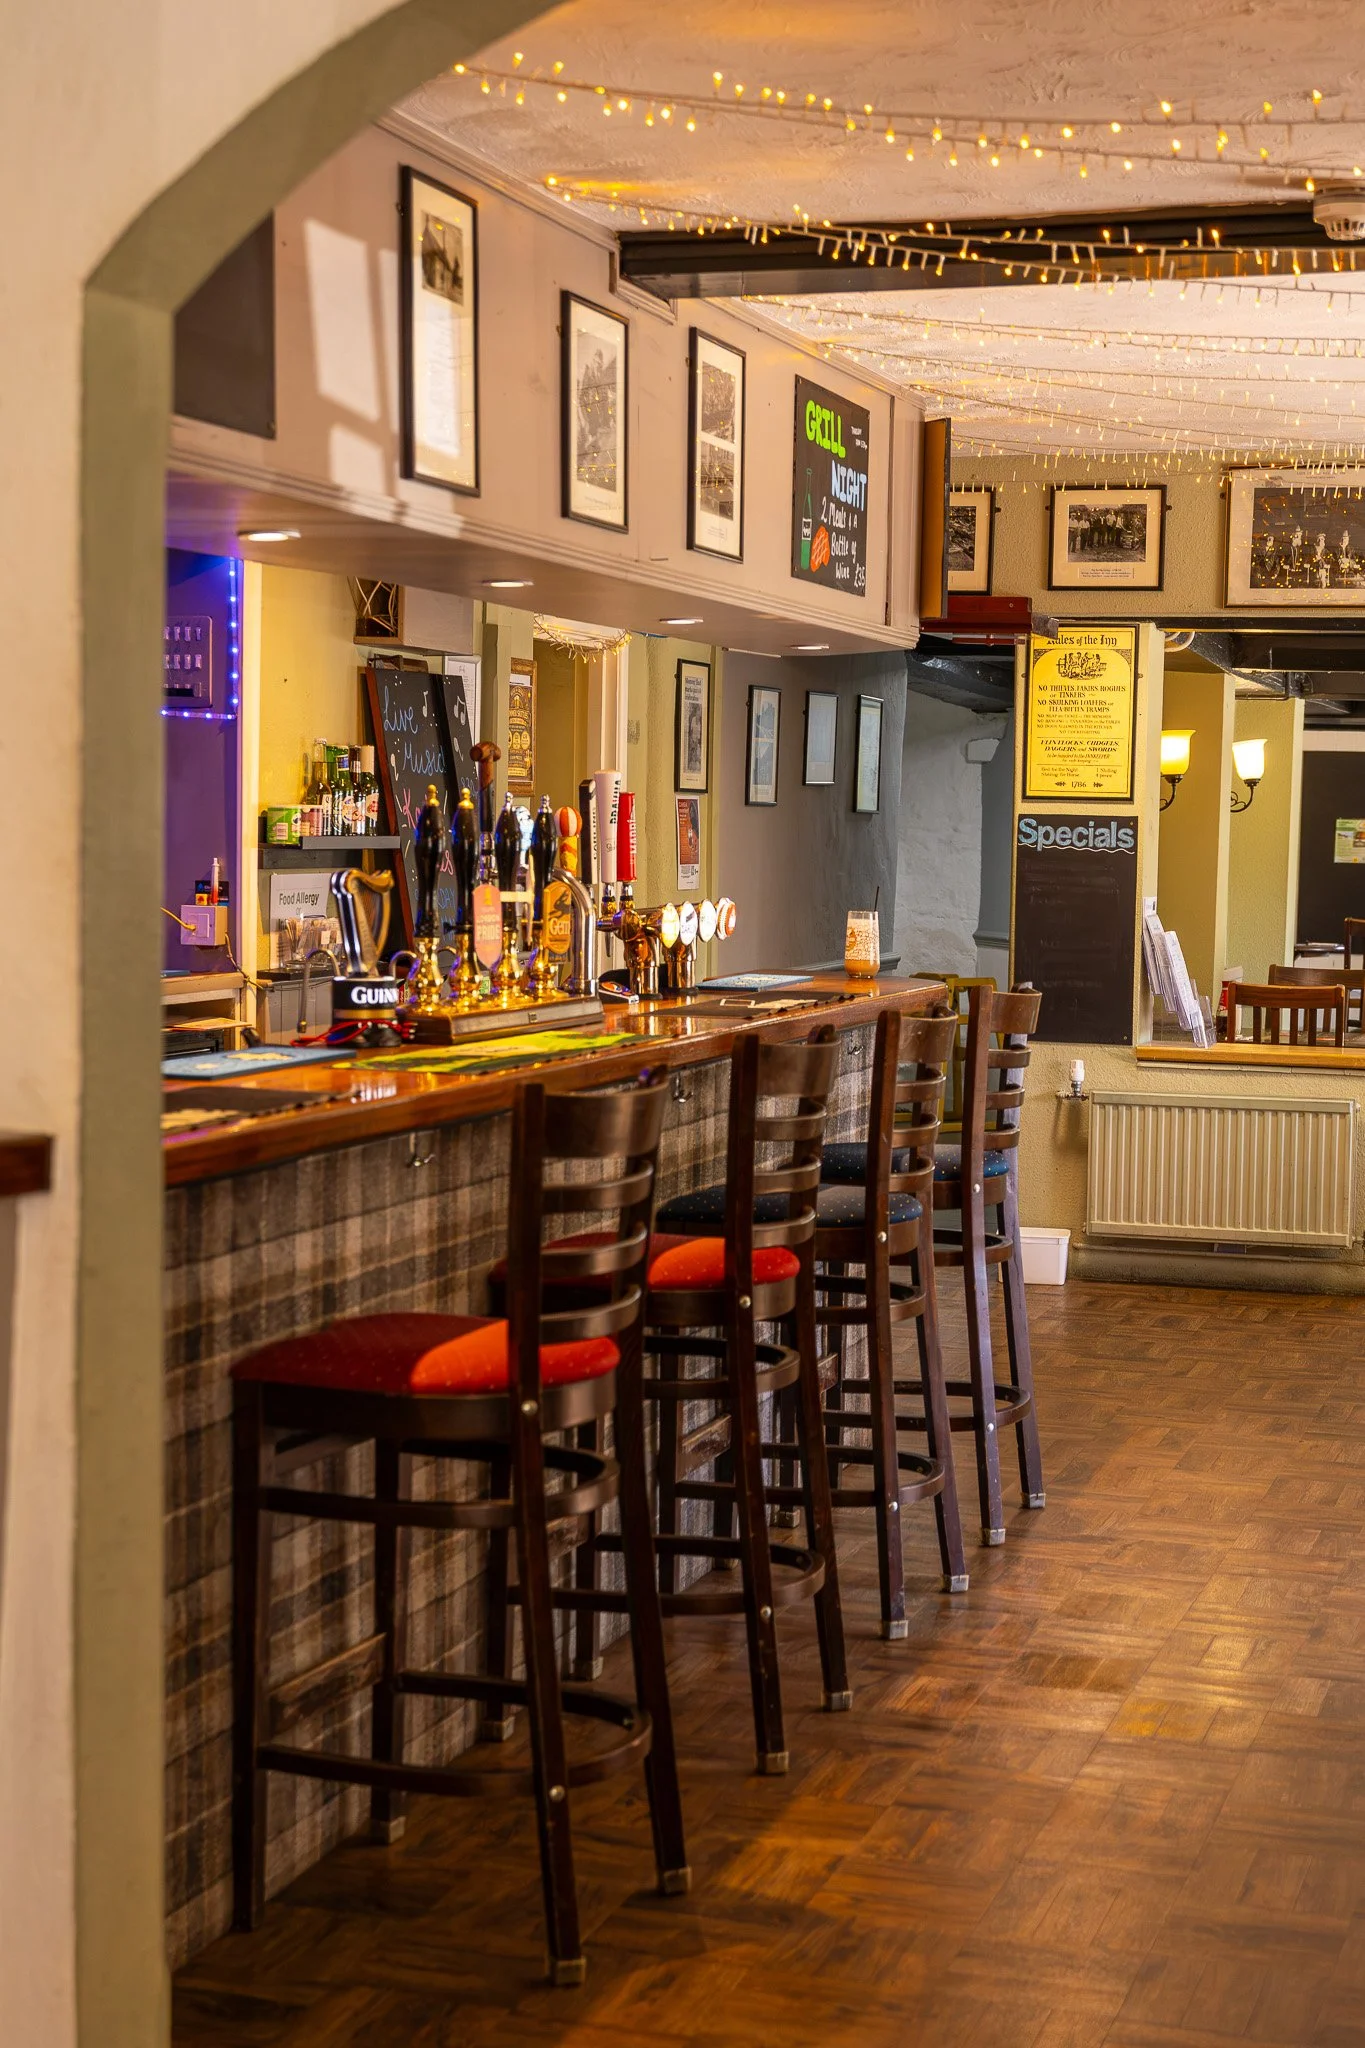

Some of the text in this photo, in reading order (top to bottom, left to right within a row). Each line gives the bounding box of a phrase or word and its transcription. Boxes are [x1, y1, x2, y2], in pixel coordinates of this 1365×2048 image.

[806, 400, 846, 459] GRILL
[832, 460, 867, 512] NIGHT
[821, 496, 828, 523] 2
[828, 502, 847, 529] Meals
[831, 532, 849, 556] Bottle
[835, 562, 850, 579] Wine
[1076, 637, 1083, 646] of
[1084, 634, 1098, 645] the
[1100, 634, 1117, 647] Inn
[384, 685, 419, 735] Live
[1018, 818, 1135, 852] Specials
[279, 891, 320, 906] Food Allergy
[476, 924, 501, 940] PRIDE
[549, 917, 571, 936] Gem
